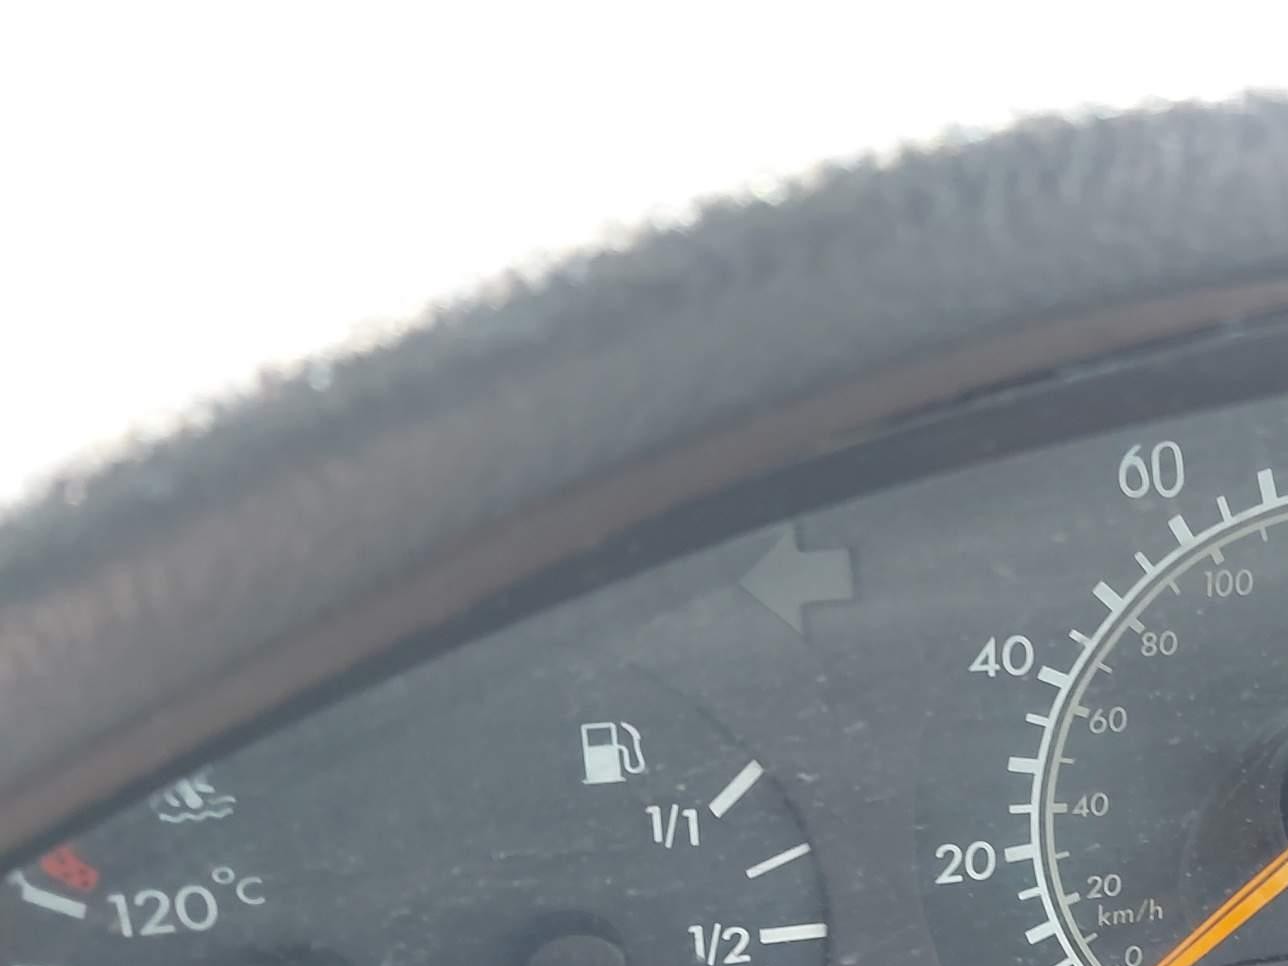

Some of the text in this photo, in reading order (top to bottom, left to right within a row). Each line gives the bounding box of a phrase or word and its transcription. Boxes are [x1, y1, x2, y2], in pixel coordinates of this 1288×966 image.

[1118, 441, 1184, 497] 60
[1205, 569, 1253, 596] 100
[969, 636, 1035, 675] 40
[1140, 631, 1178, 657] 80
[1089, 707, 1127, 732] 60
[1073, 793, 1108, 817] 40
[646, 804, 700, 847] 1/1
[935, 840, 996, 884] 20
[1086, 875, 1121, 897] 20
[1097, 900, 1164, 925] km/h
[688, 924, 751, 965] 1/2
